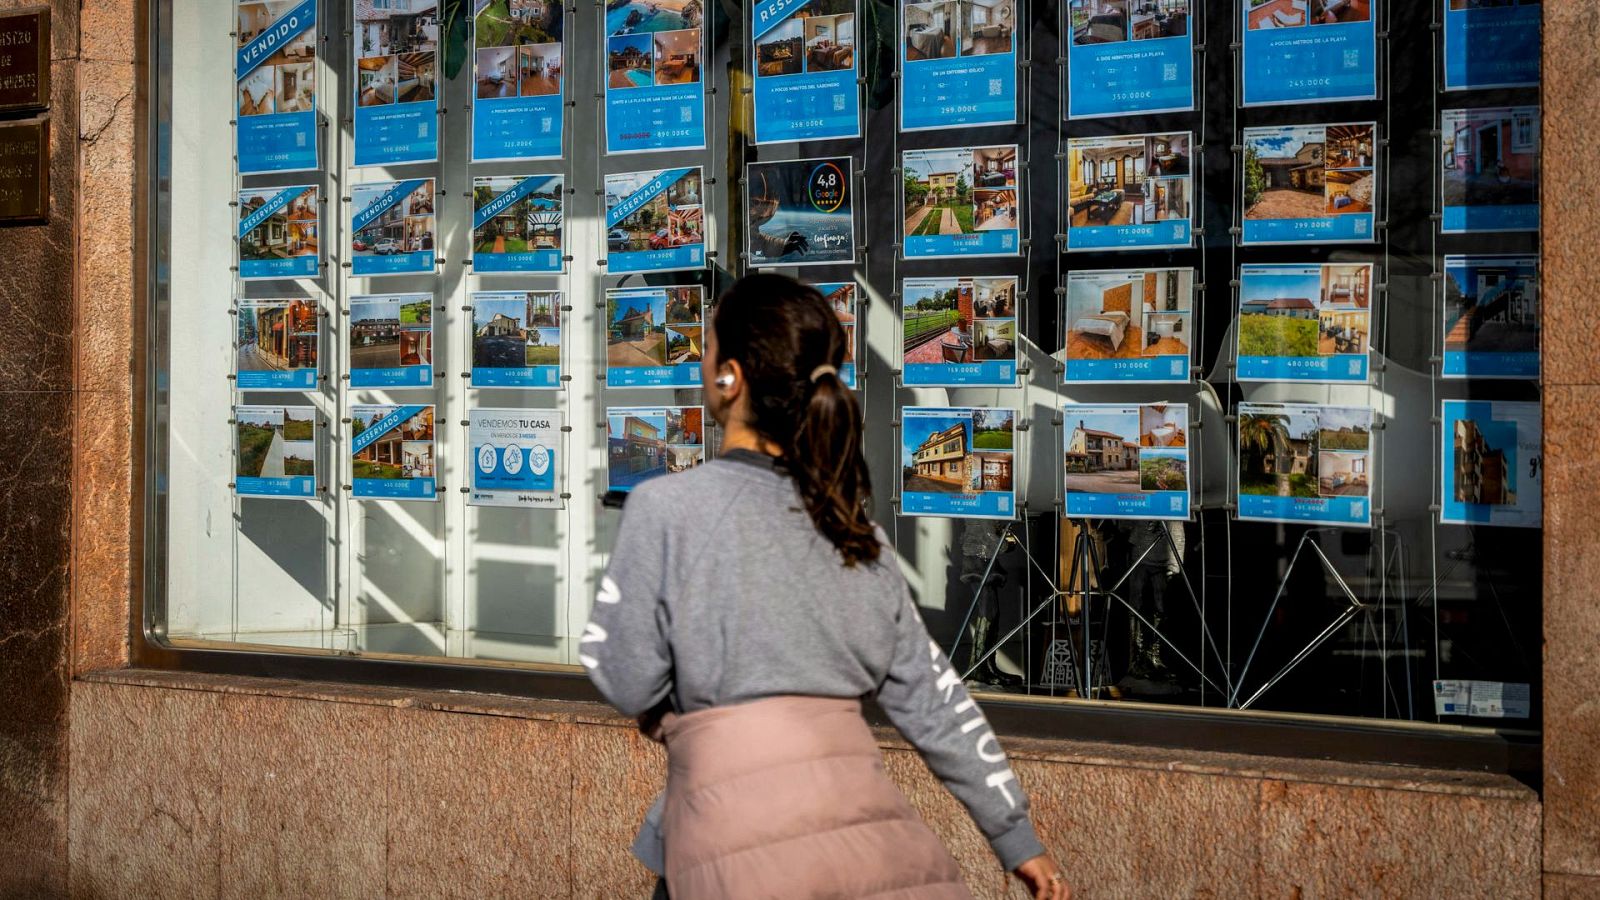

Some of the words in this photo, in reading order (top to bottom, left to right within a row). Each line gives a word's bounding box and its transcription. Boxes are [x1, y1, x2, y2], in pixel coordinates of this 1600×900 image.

[242, 15, 298, 64] VENDIDO
[1289, 79, 1330, 88] 245.000€
[815, 189, 839, 199] Google
[816, 173, 836, 188] 4,8
[243, 196, 284, 231] RESERVADO
[360, 194, 394, 223] VENDIDO
[481, 190, 517, 218] VENDIDO
[612, 180, 662, 220] RESERVADO
[356, 414, 400, 447] RESERVADO
[478, 419, 517, 428] VENDEMOS
[519, 420, 528, 428] TU
[530, 420, 551, 429] CASA
